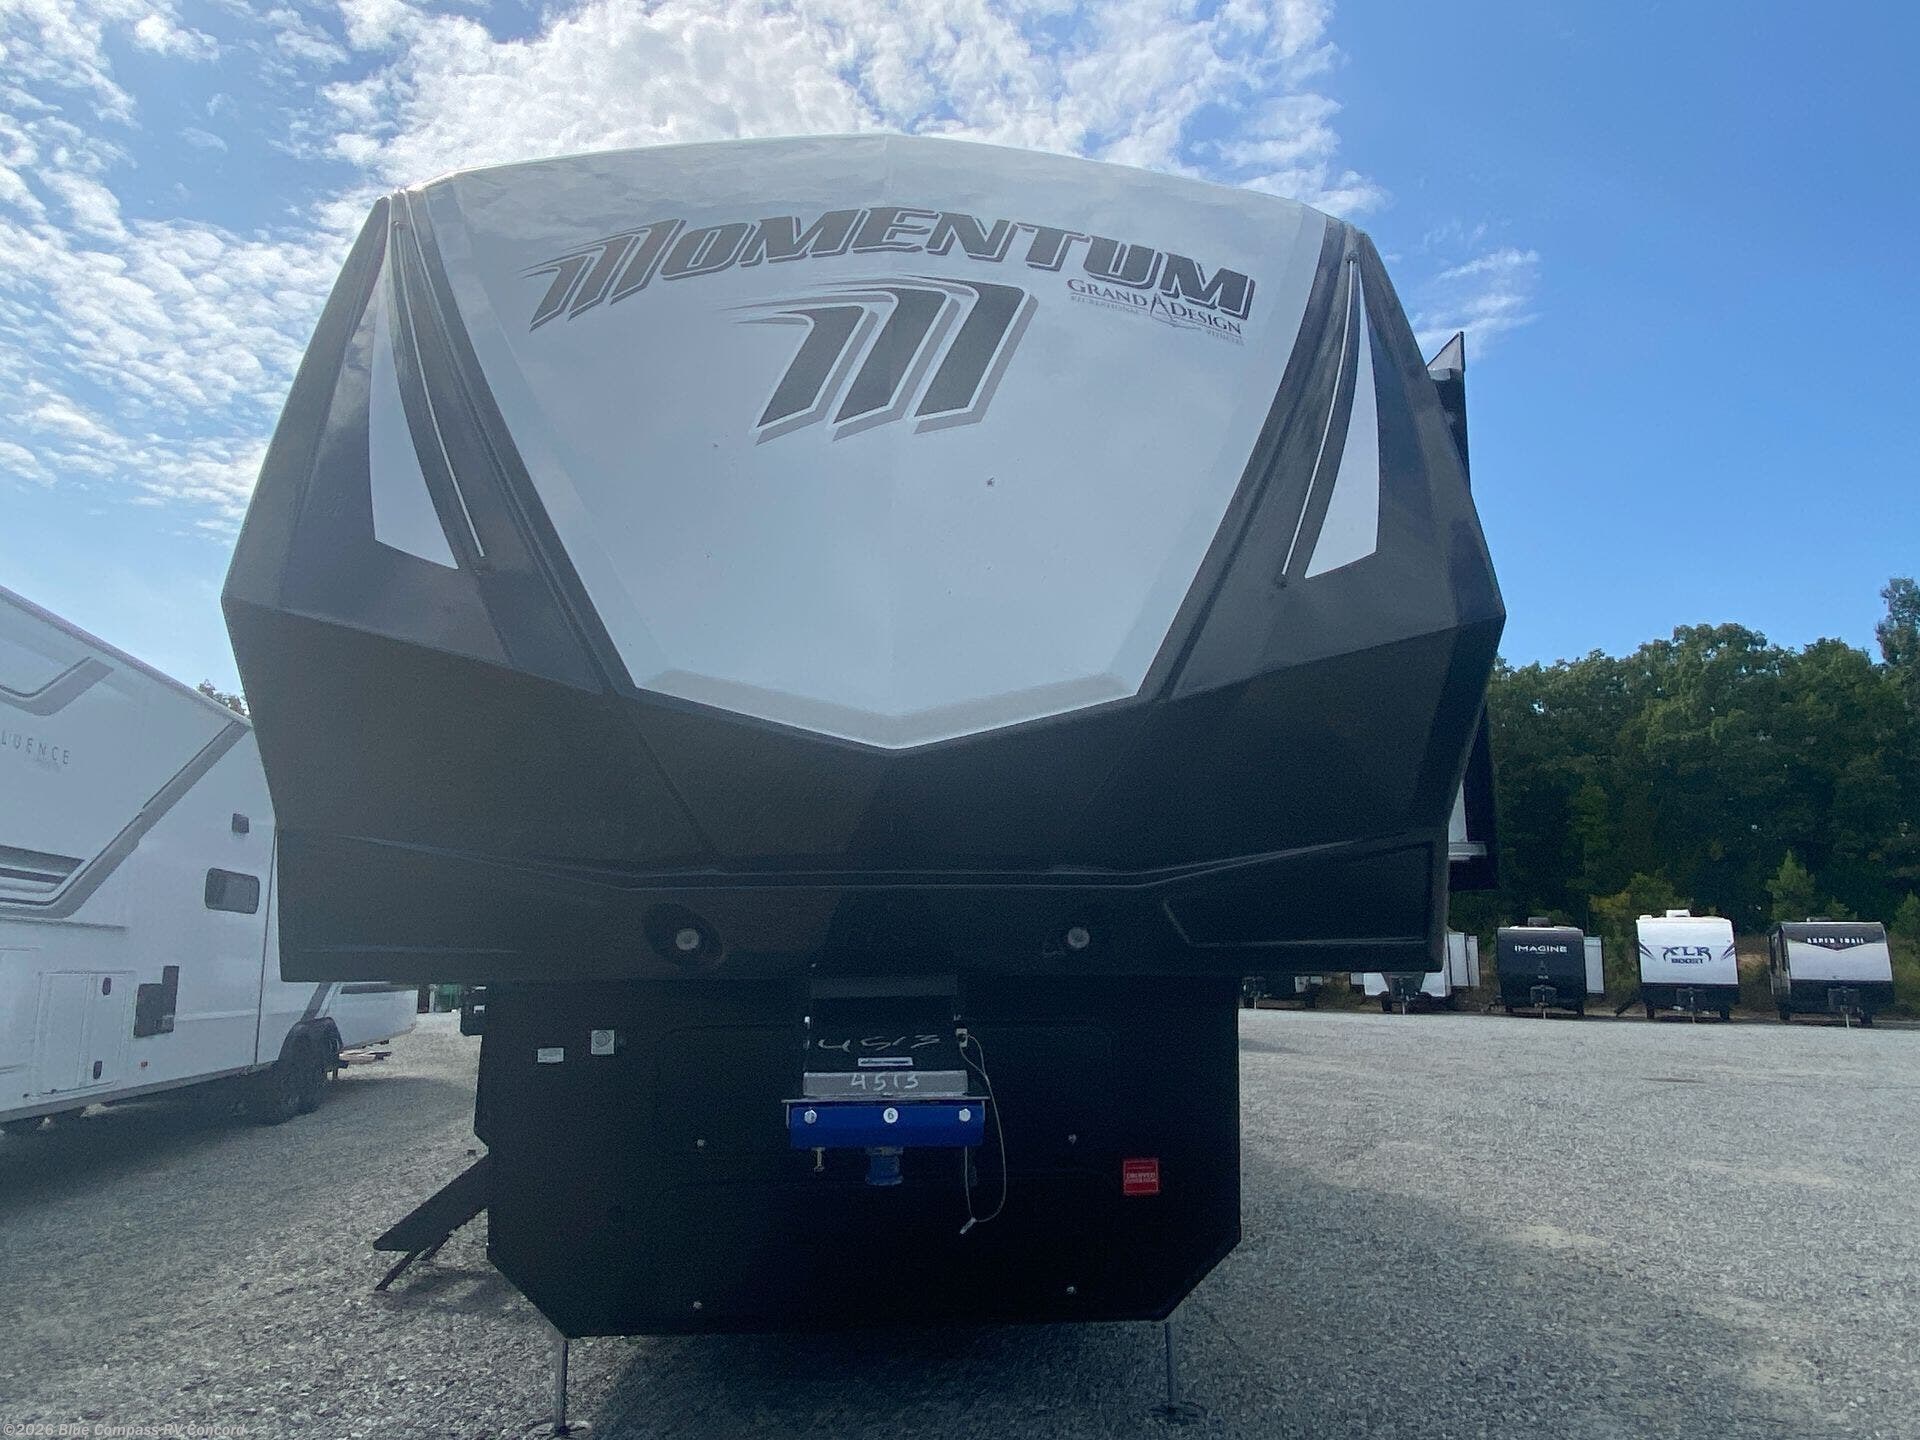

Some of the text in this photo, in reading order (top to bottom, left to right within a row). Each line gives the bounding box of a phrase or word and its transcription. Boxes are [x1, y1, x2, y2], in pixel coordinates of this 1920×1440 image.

[524, 206, 1257, 331] MOMENTUM
[1066, 278, 1149, 307] GRAND
[1170, 301, 1242, 335] DESIGN
[1513, 944, 1568, 954] IMAGINE
[1661, 945, 1712, 962] XLR
[850, 1073, 920, 1092] 4513
